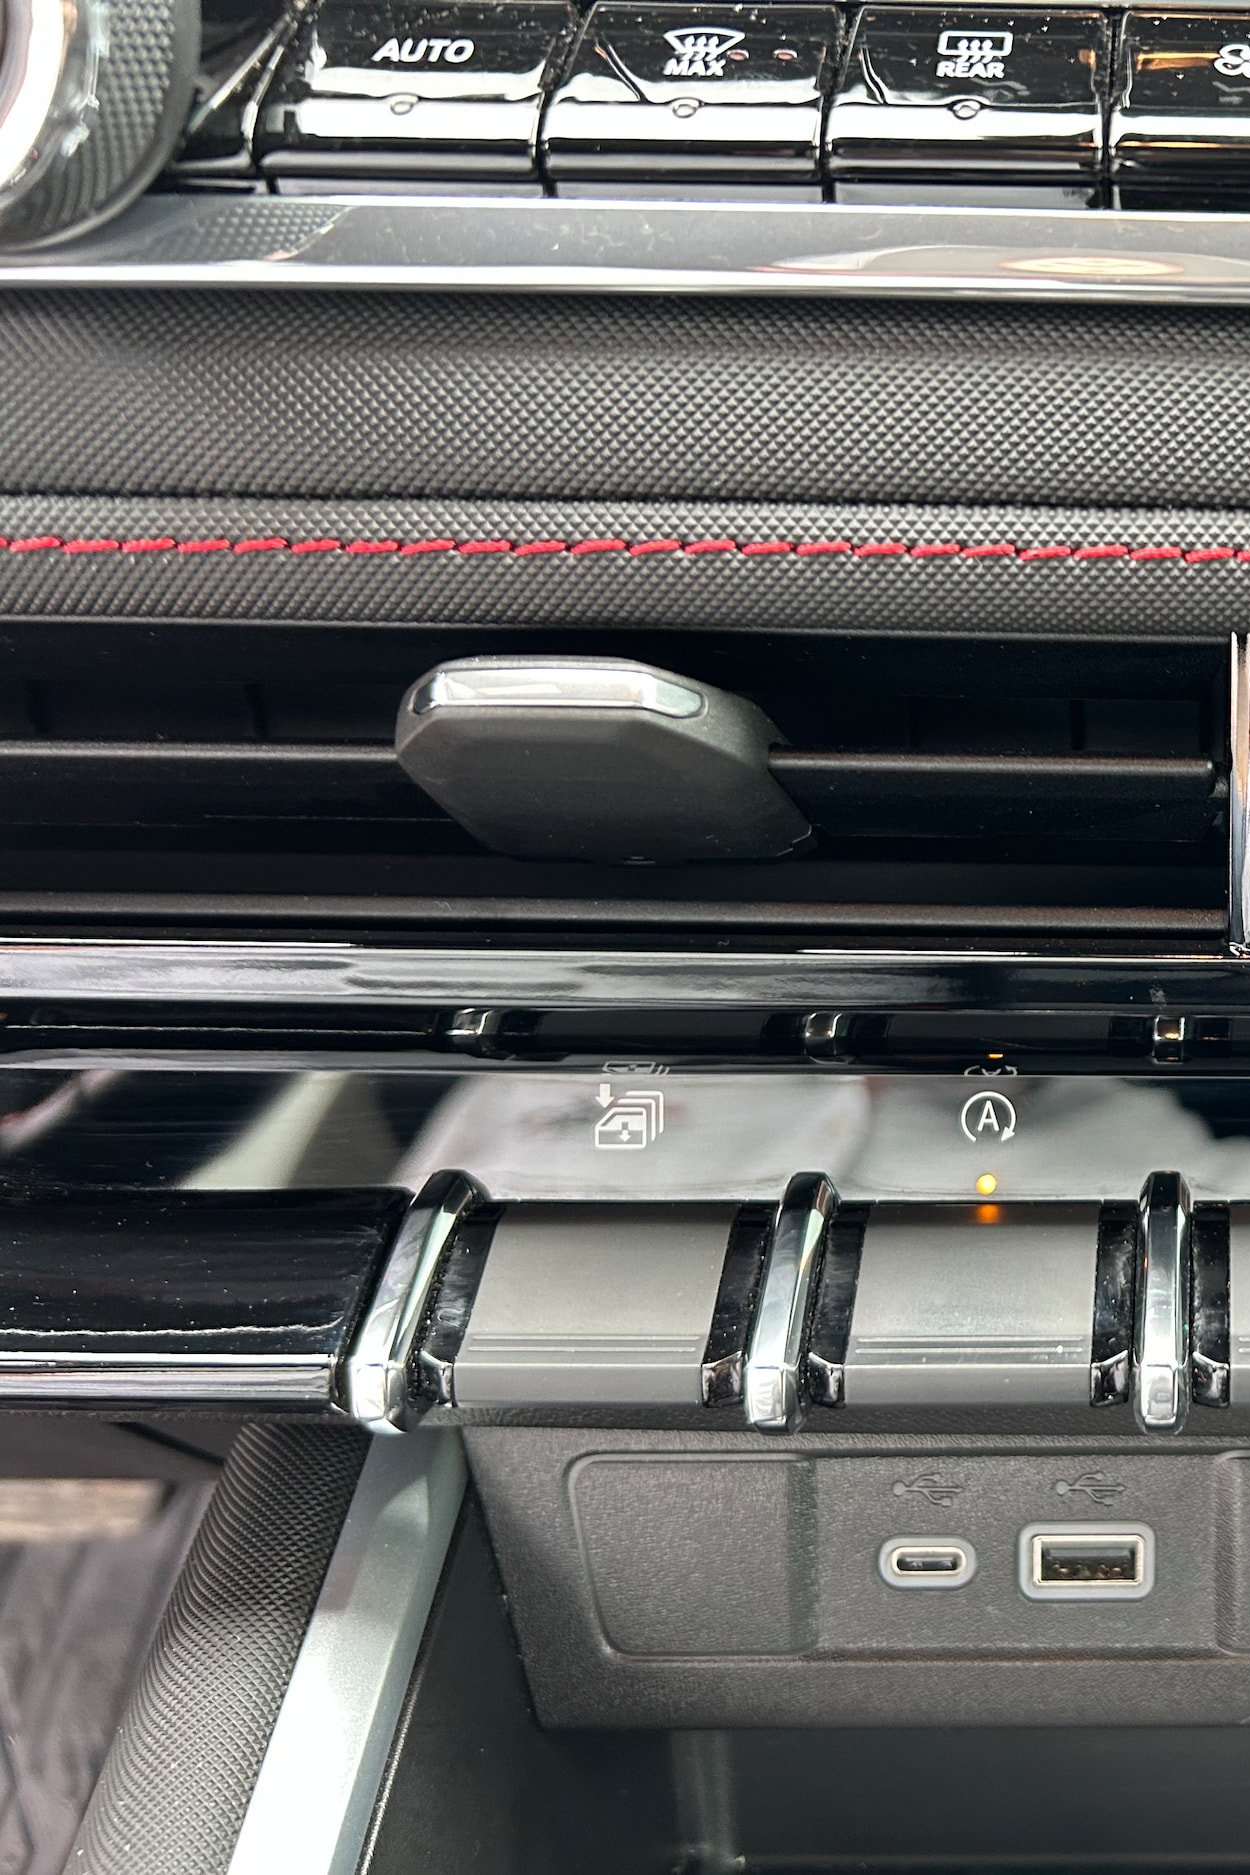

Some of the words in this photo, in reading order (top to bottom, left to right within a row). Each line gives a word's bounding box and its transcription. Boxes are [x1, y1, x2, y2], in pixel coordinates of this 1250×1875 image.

[371, 37, 475, 64] AUTO
[662, 58, 726, 76] MAX
[936, 61, 1005, 78] REAR
[977, 1100, 1000, 1131] A
